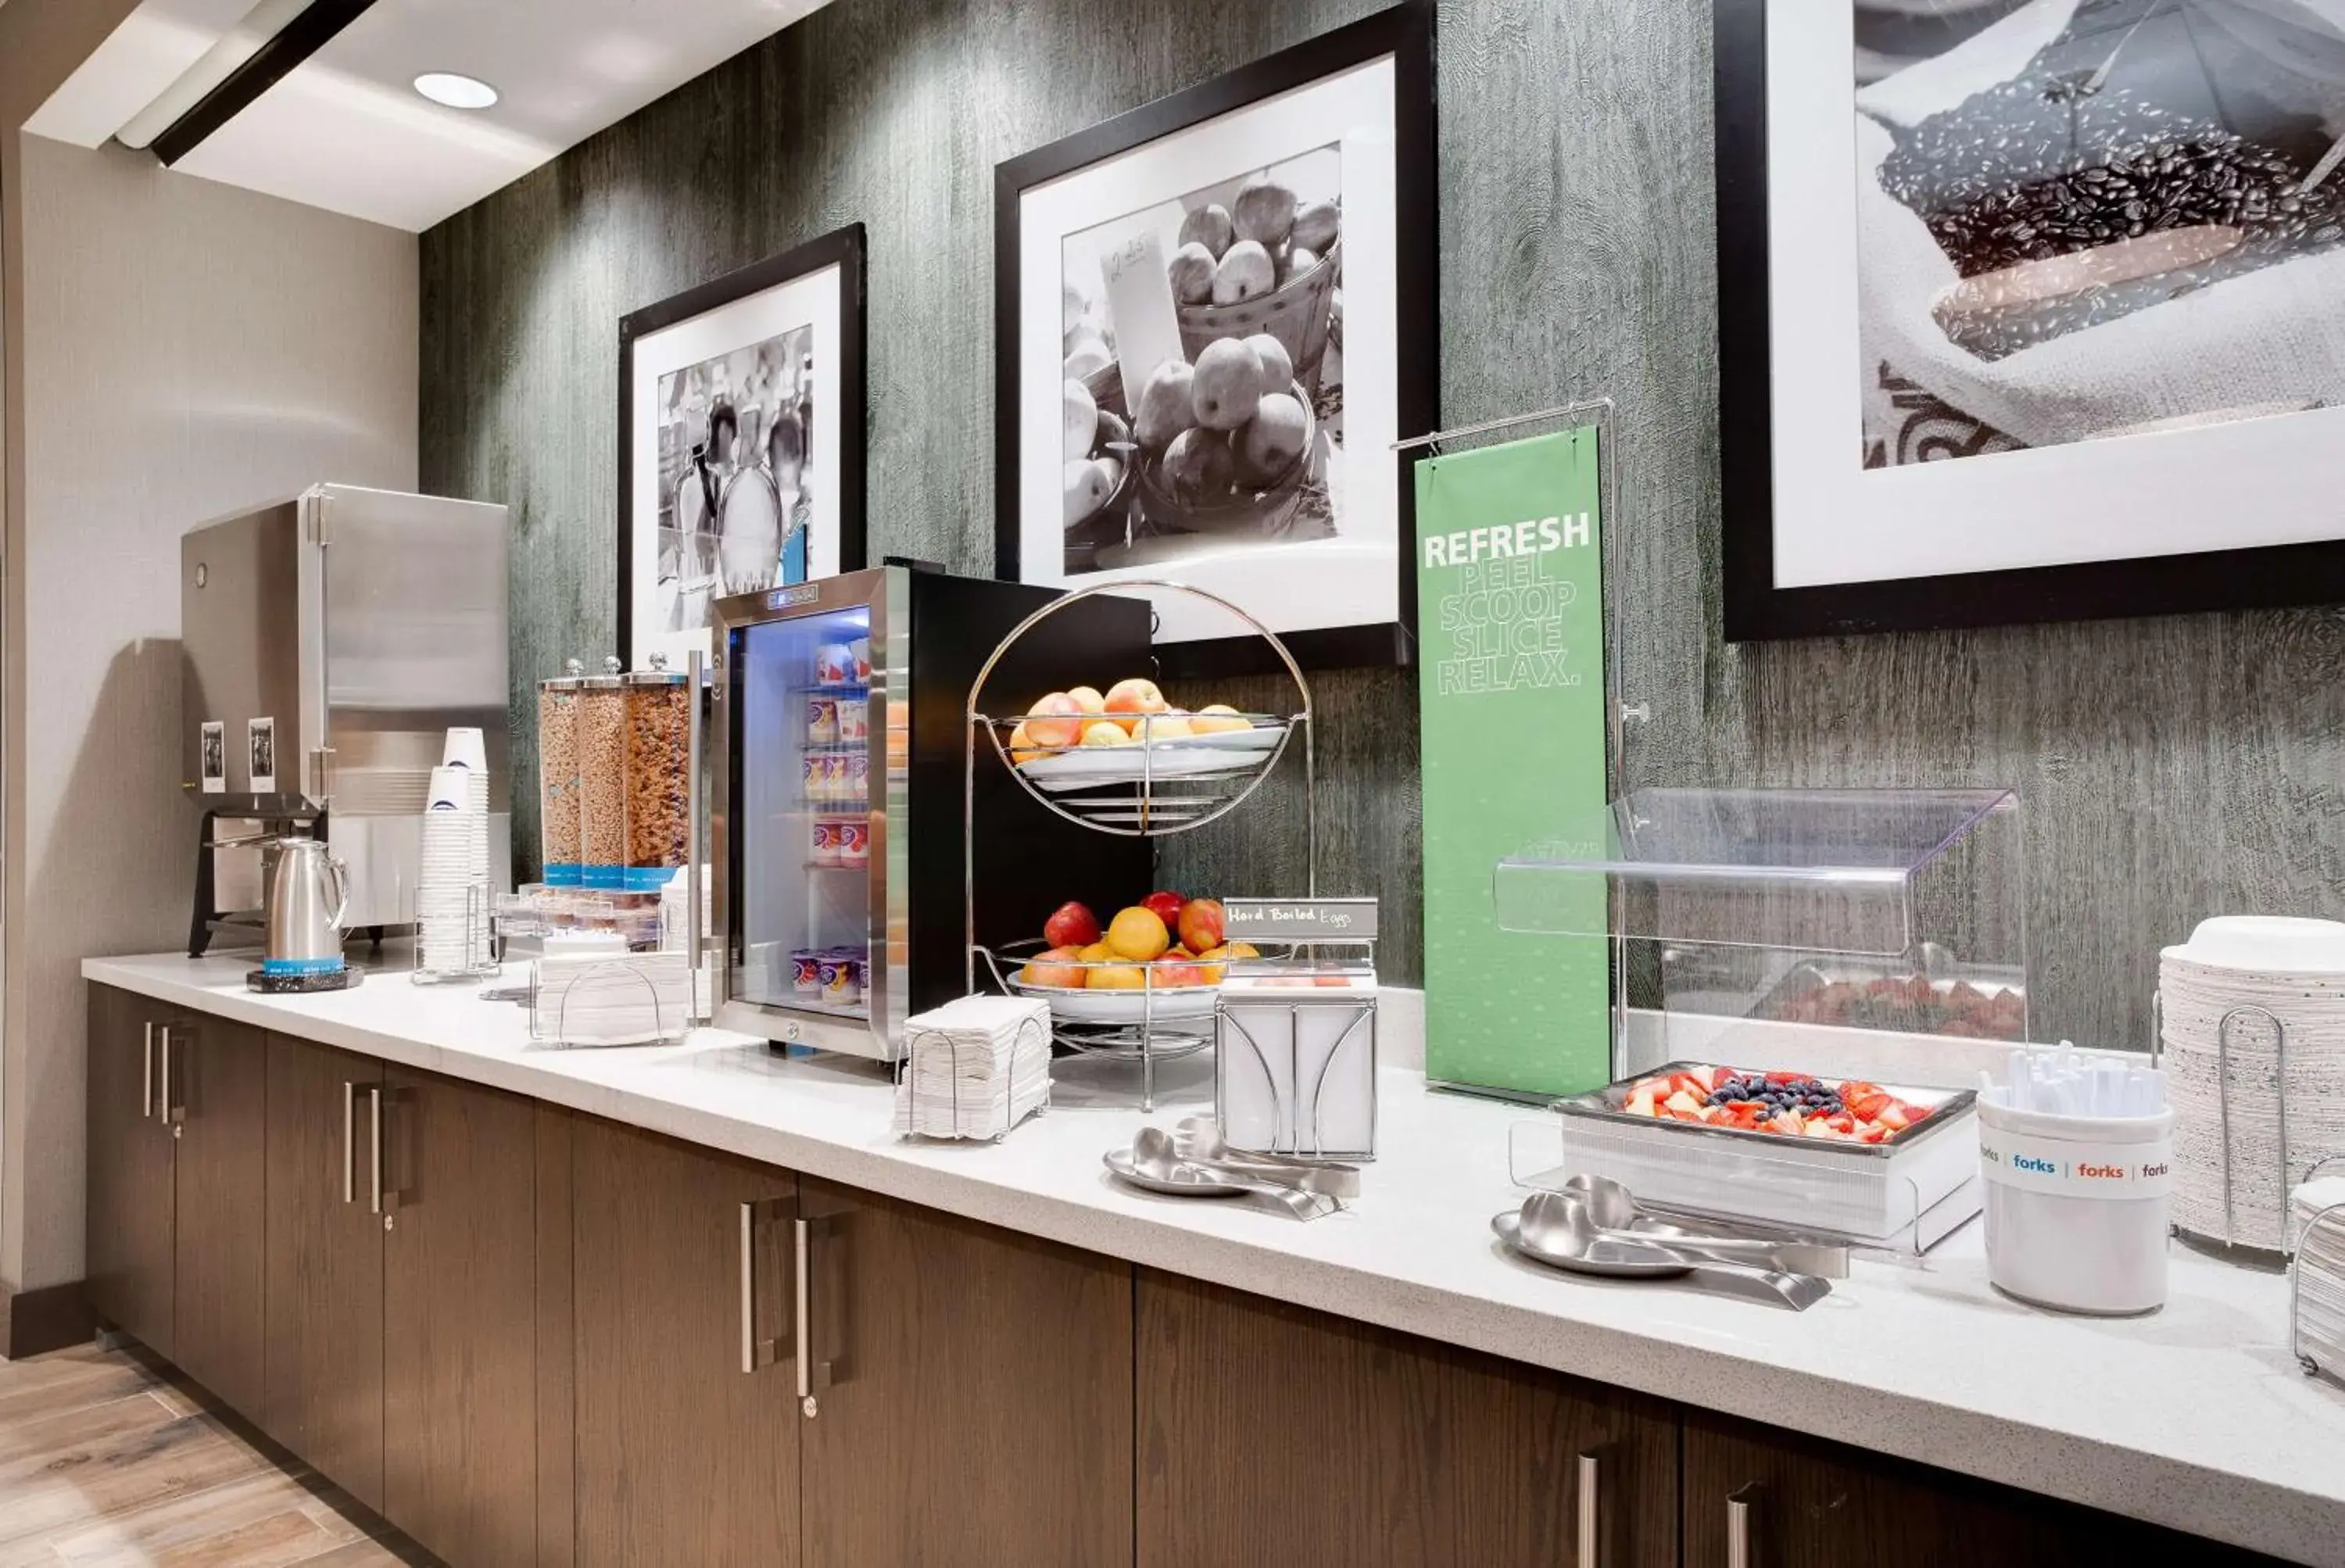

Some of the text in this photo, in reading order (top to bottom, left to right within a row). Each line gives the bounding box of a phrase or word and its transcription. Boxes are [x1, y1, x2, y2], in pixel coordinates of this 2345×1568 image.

[1424, 512, 1589, 568] REFRESH
[1459, 554, 1553, 595] PEEL
[1439, 581, 1577, 631] SCOOP
[1452, 616, 1563, 660] SLICE
[1437, 650, 1581, 696] RELAX.
[1228, 907, 1352, 928] Hard Boiled Eggs
[2014, 1155, 2055, 1173] forks
[2077, 1163, 2124, 1178] forks
